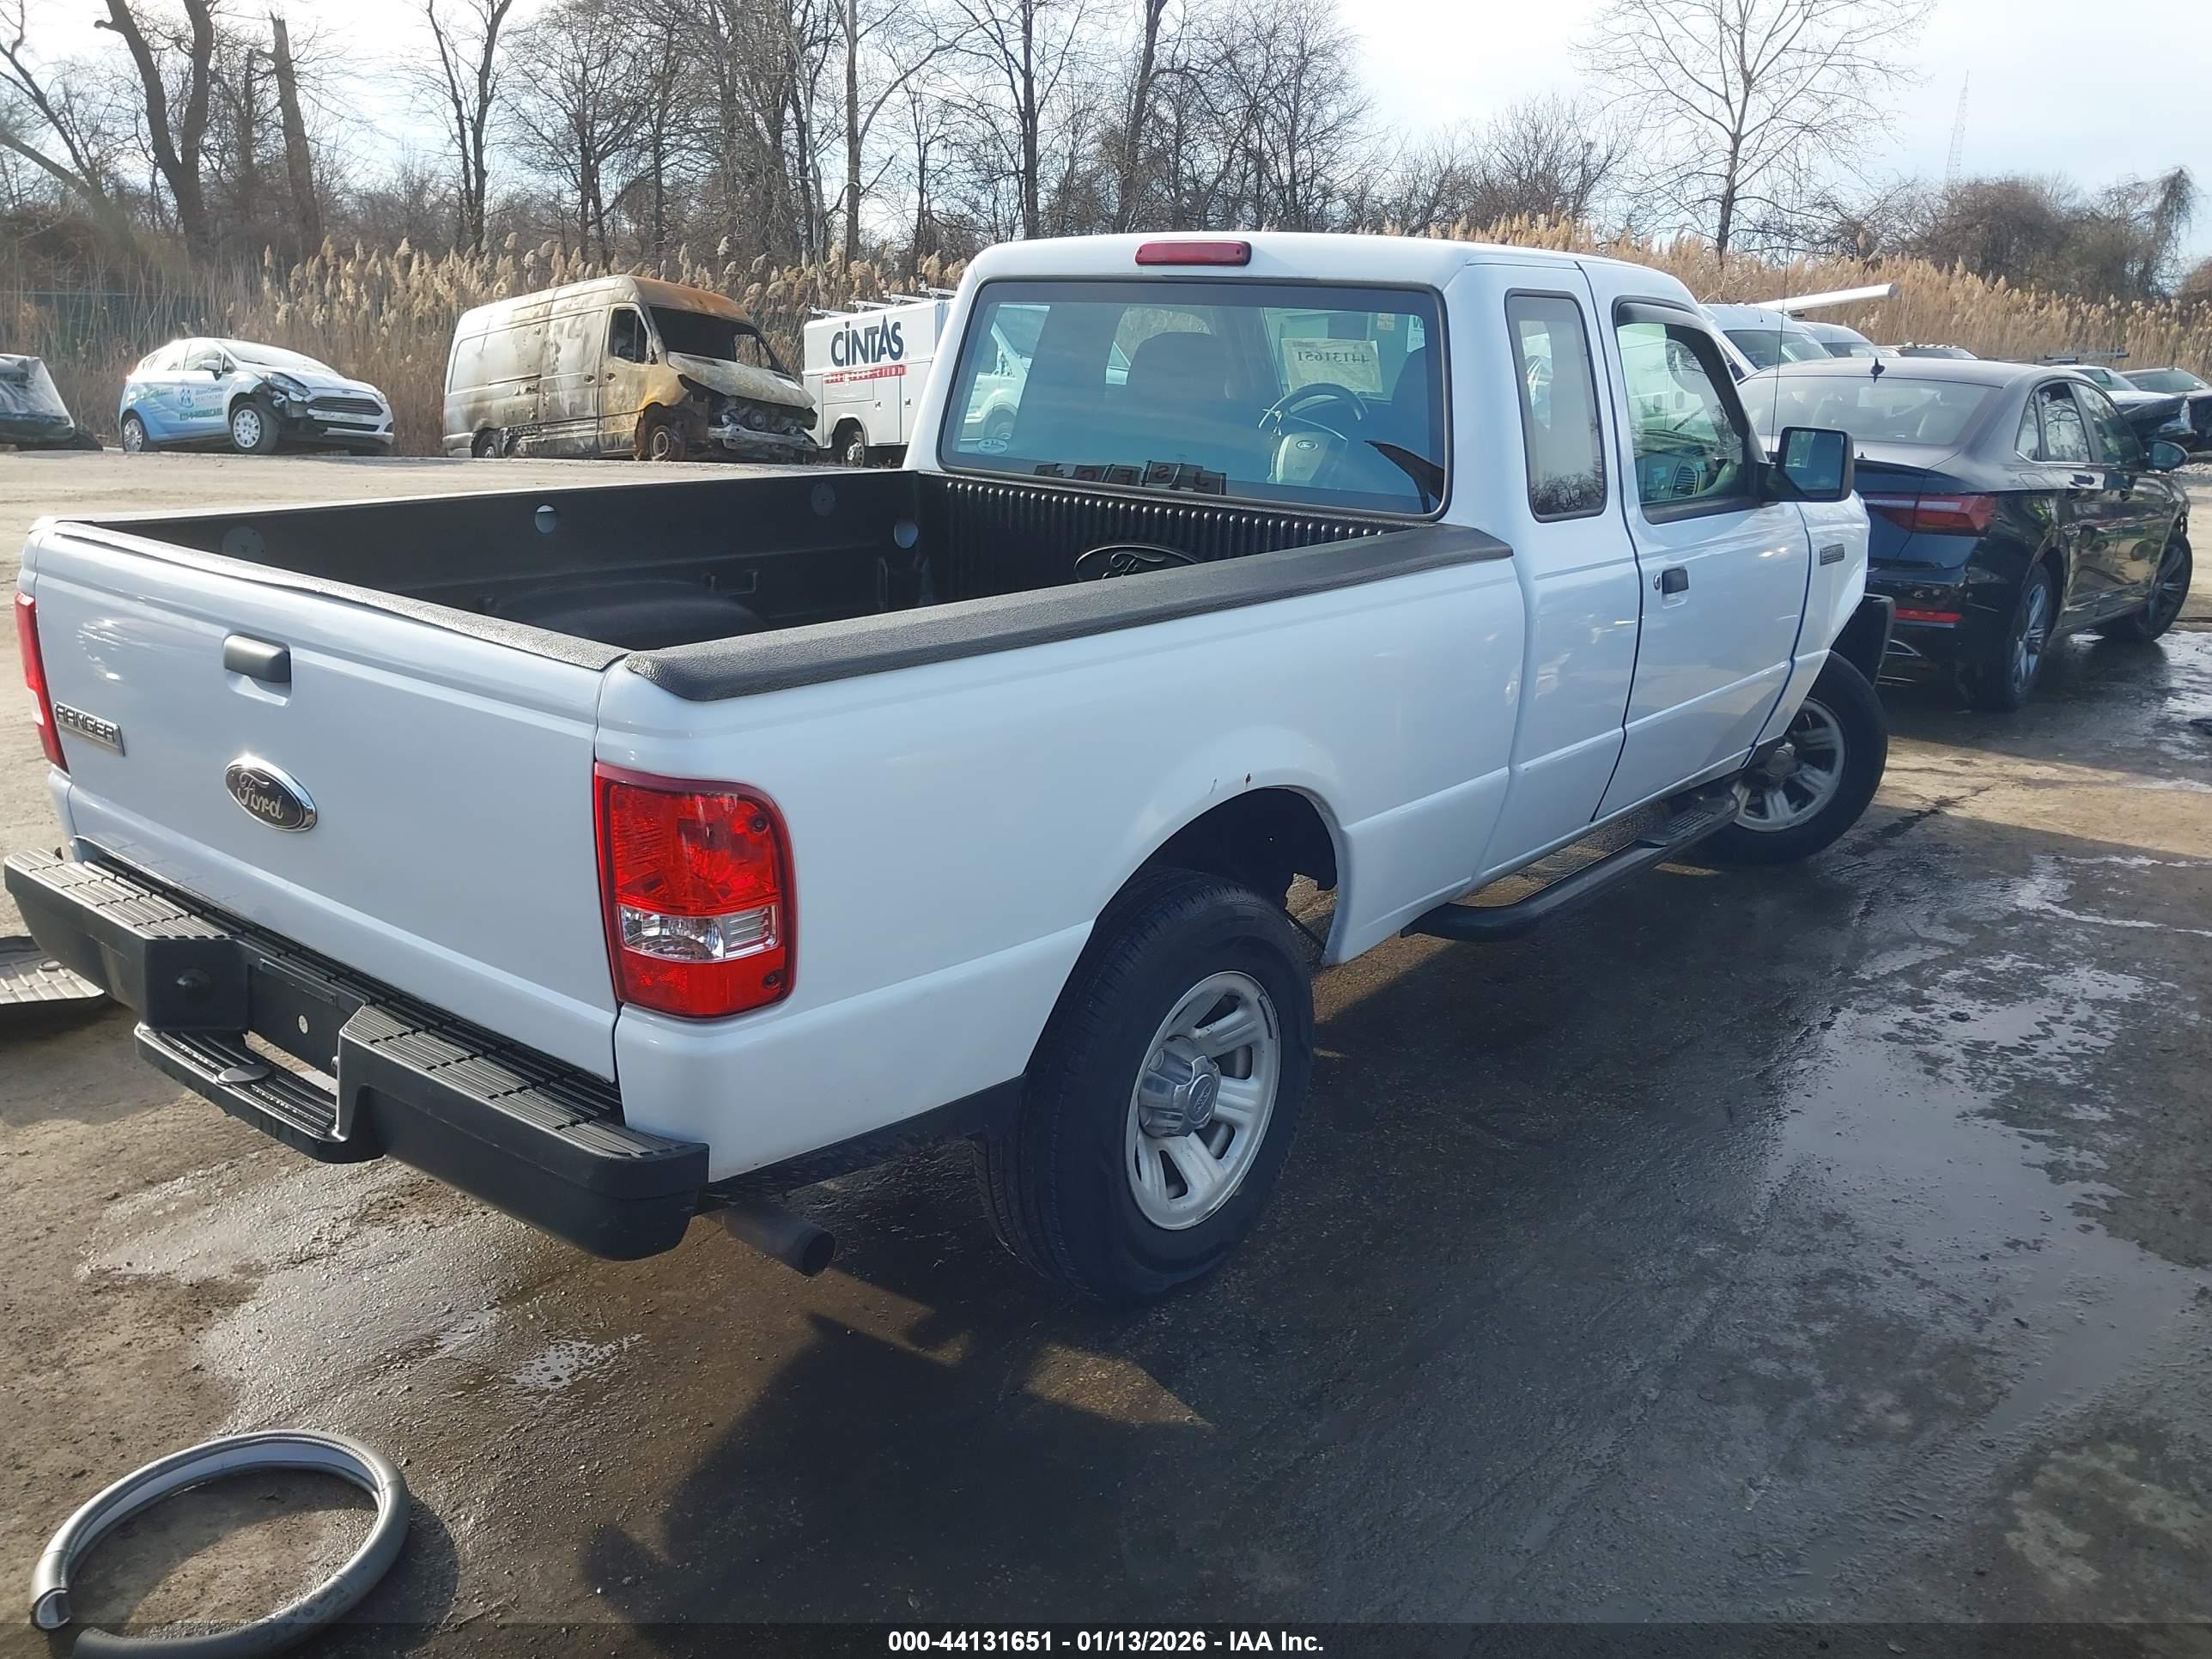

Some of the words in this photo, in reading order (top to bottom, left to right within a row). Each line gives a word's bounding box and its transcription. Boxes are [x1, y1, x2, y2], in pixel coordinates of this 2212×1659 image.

[830, 314, 904, 367] CINTAS
[55, 704, 115, 742] RANGER
[237, 772, 283, 819] Ford
